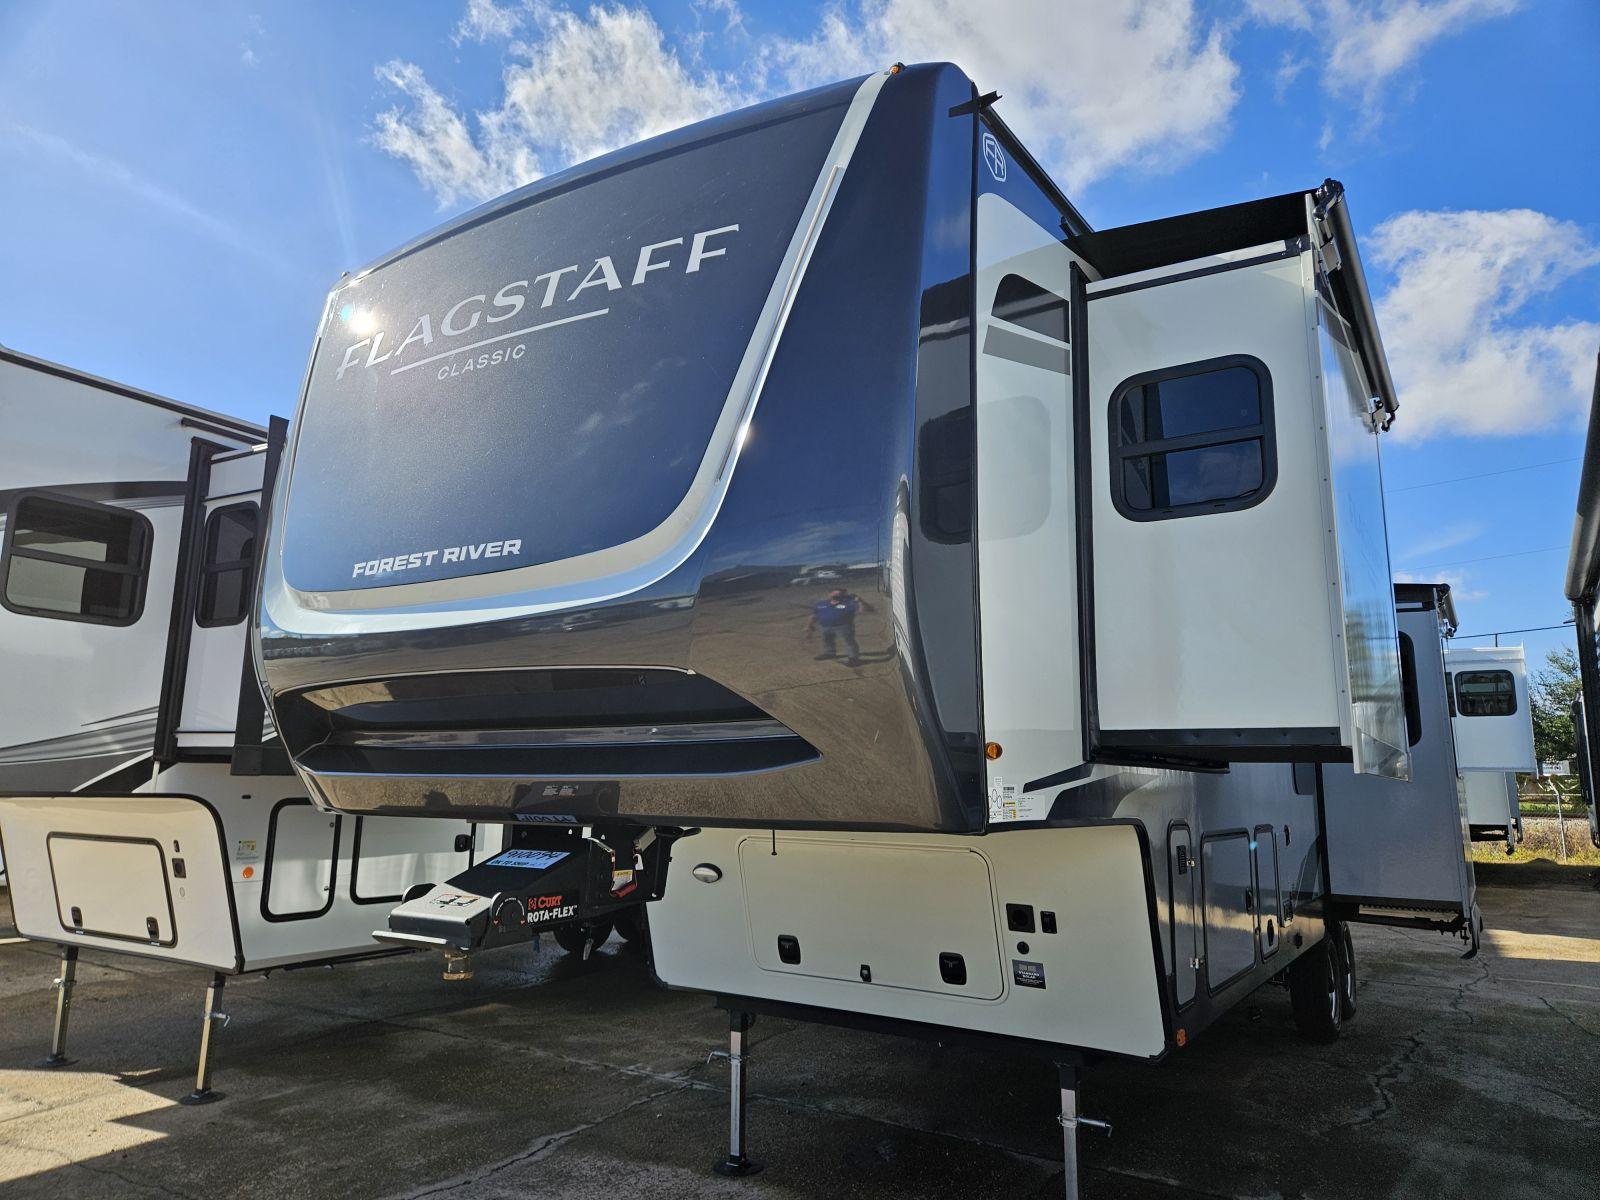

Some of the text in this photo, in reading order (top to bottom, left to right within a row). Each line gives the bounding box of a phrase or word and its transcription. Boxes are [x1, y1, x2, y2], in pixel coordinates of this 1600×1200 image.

[335, 223, 740, 381] FLAGSTAFF
[436, 343, 527, 381] CLASSIC
[352, 538, 522, 578] FOREST RIVER
[538, 896, 562, 909] CURT
